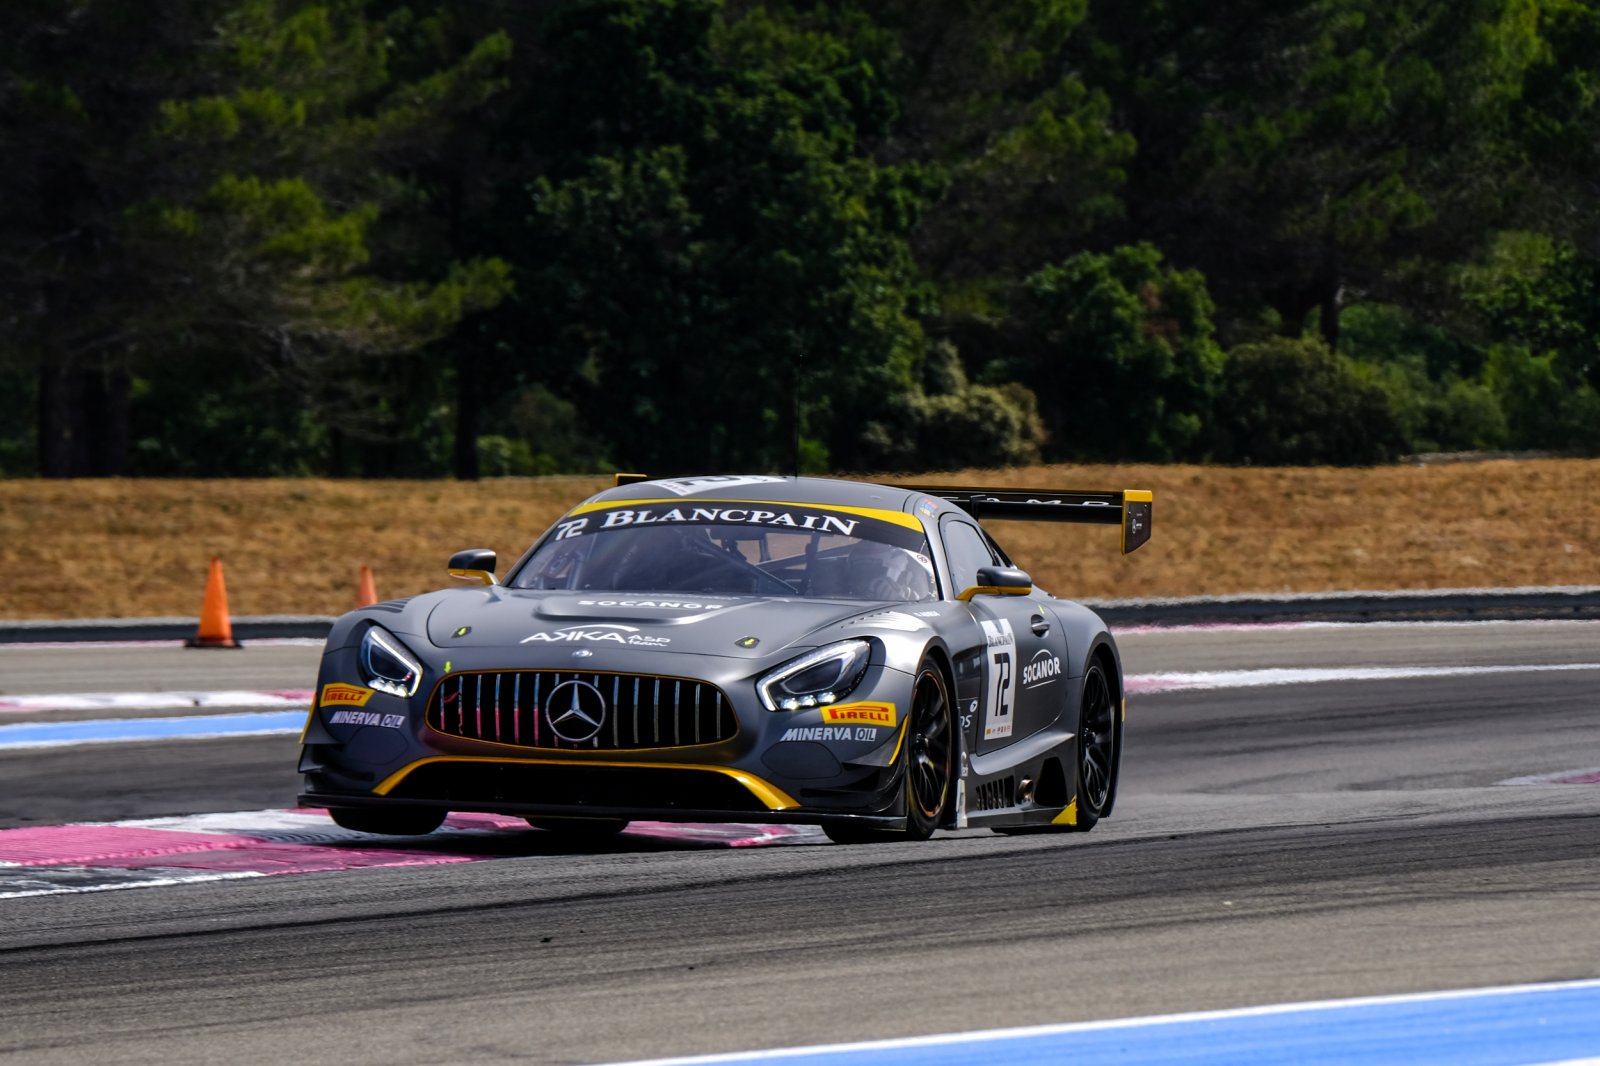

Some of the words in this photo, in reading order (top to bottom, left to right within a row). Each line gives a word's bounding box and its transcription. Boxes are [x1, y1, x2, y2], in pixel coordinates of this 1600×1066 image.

[555, 518, 589, 541] 72
[600, 508, 860, 536] BLANCPAIN
[1022, 656, 1062, 685] SOCANOR
[324, 687, 367, 702] PIRELLI
[994, 652, 1011, 717] 72
[329, 711, 381, 726] MINERVA
[382, 714, 405, 728] OIL
[828, 706, 889, 721] PIRELLI
[780, 727, 852, 741] MINERVA
[855, 728, 877, 741] OIL
